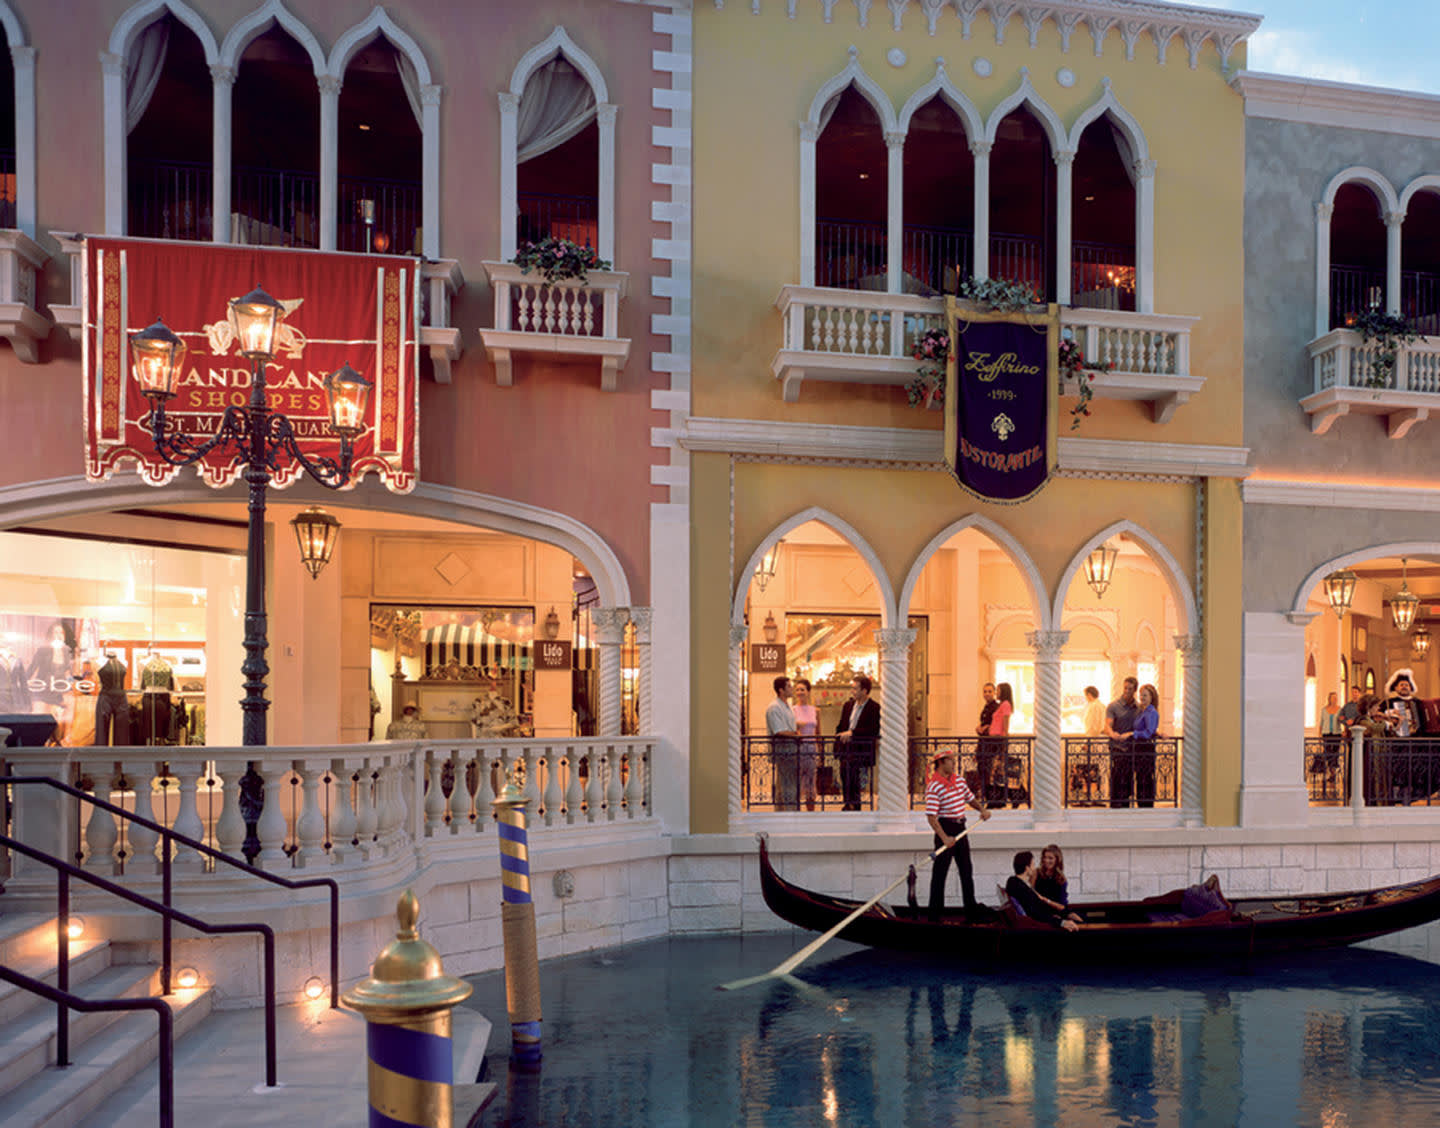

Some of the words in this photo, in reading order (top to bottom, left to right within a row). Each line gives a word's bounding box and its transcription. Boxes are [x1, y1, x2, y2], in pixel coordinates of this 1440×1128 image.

[964, 351, 1040, 382] Zeffirino
[189, 391, 321, 411] SHOPES
[271, 418, 341, 437] SUAR
[543, 643, 564, 657] Lido
